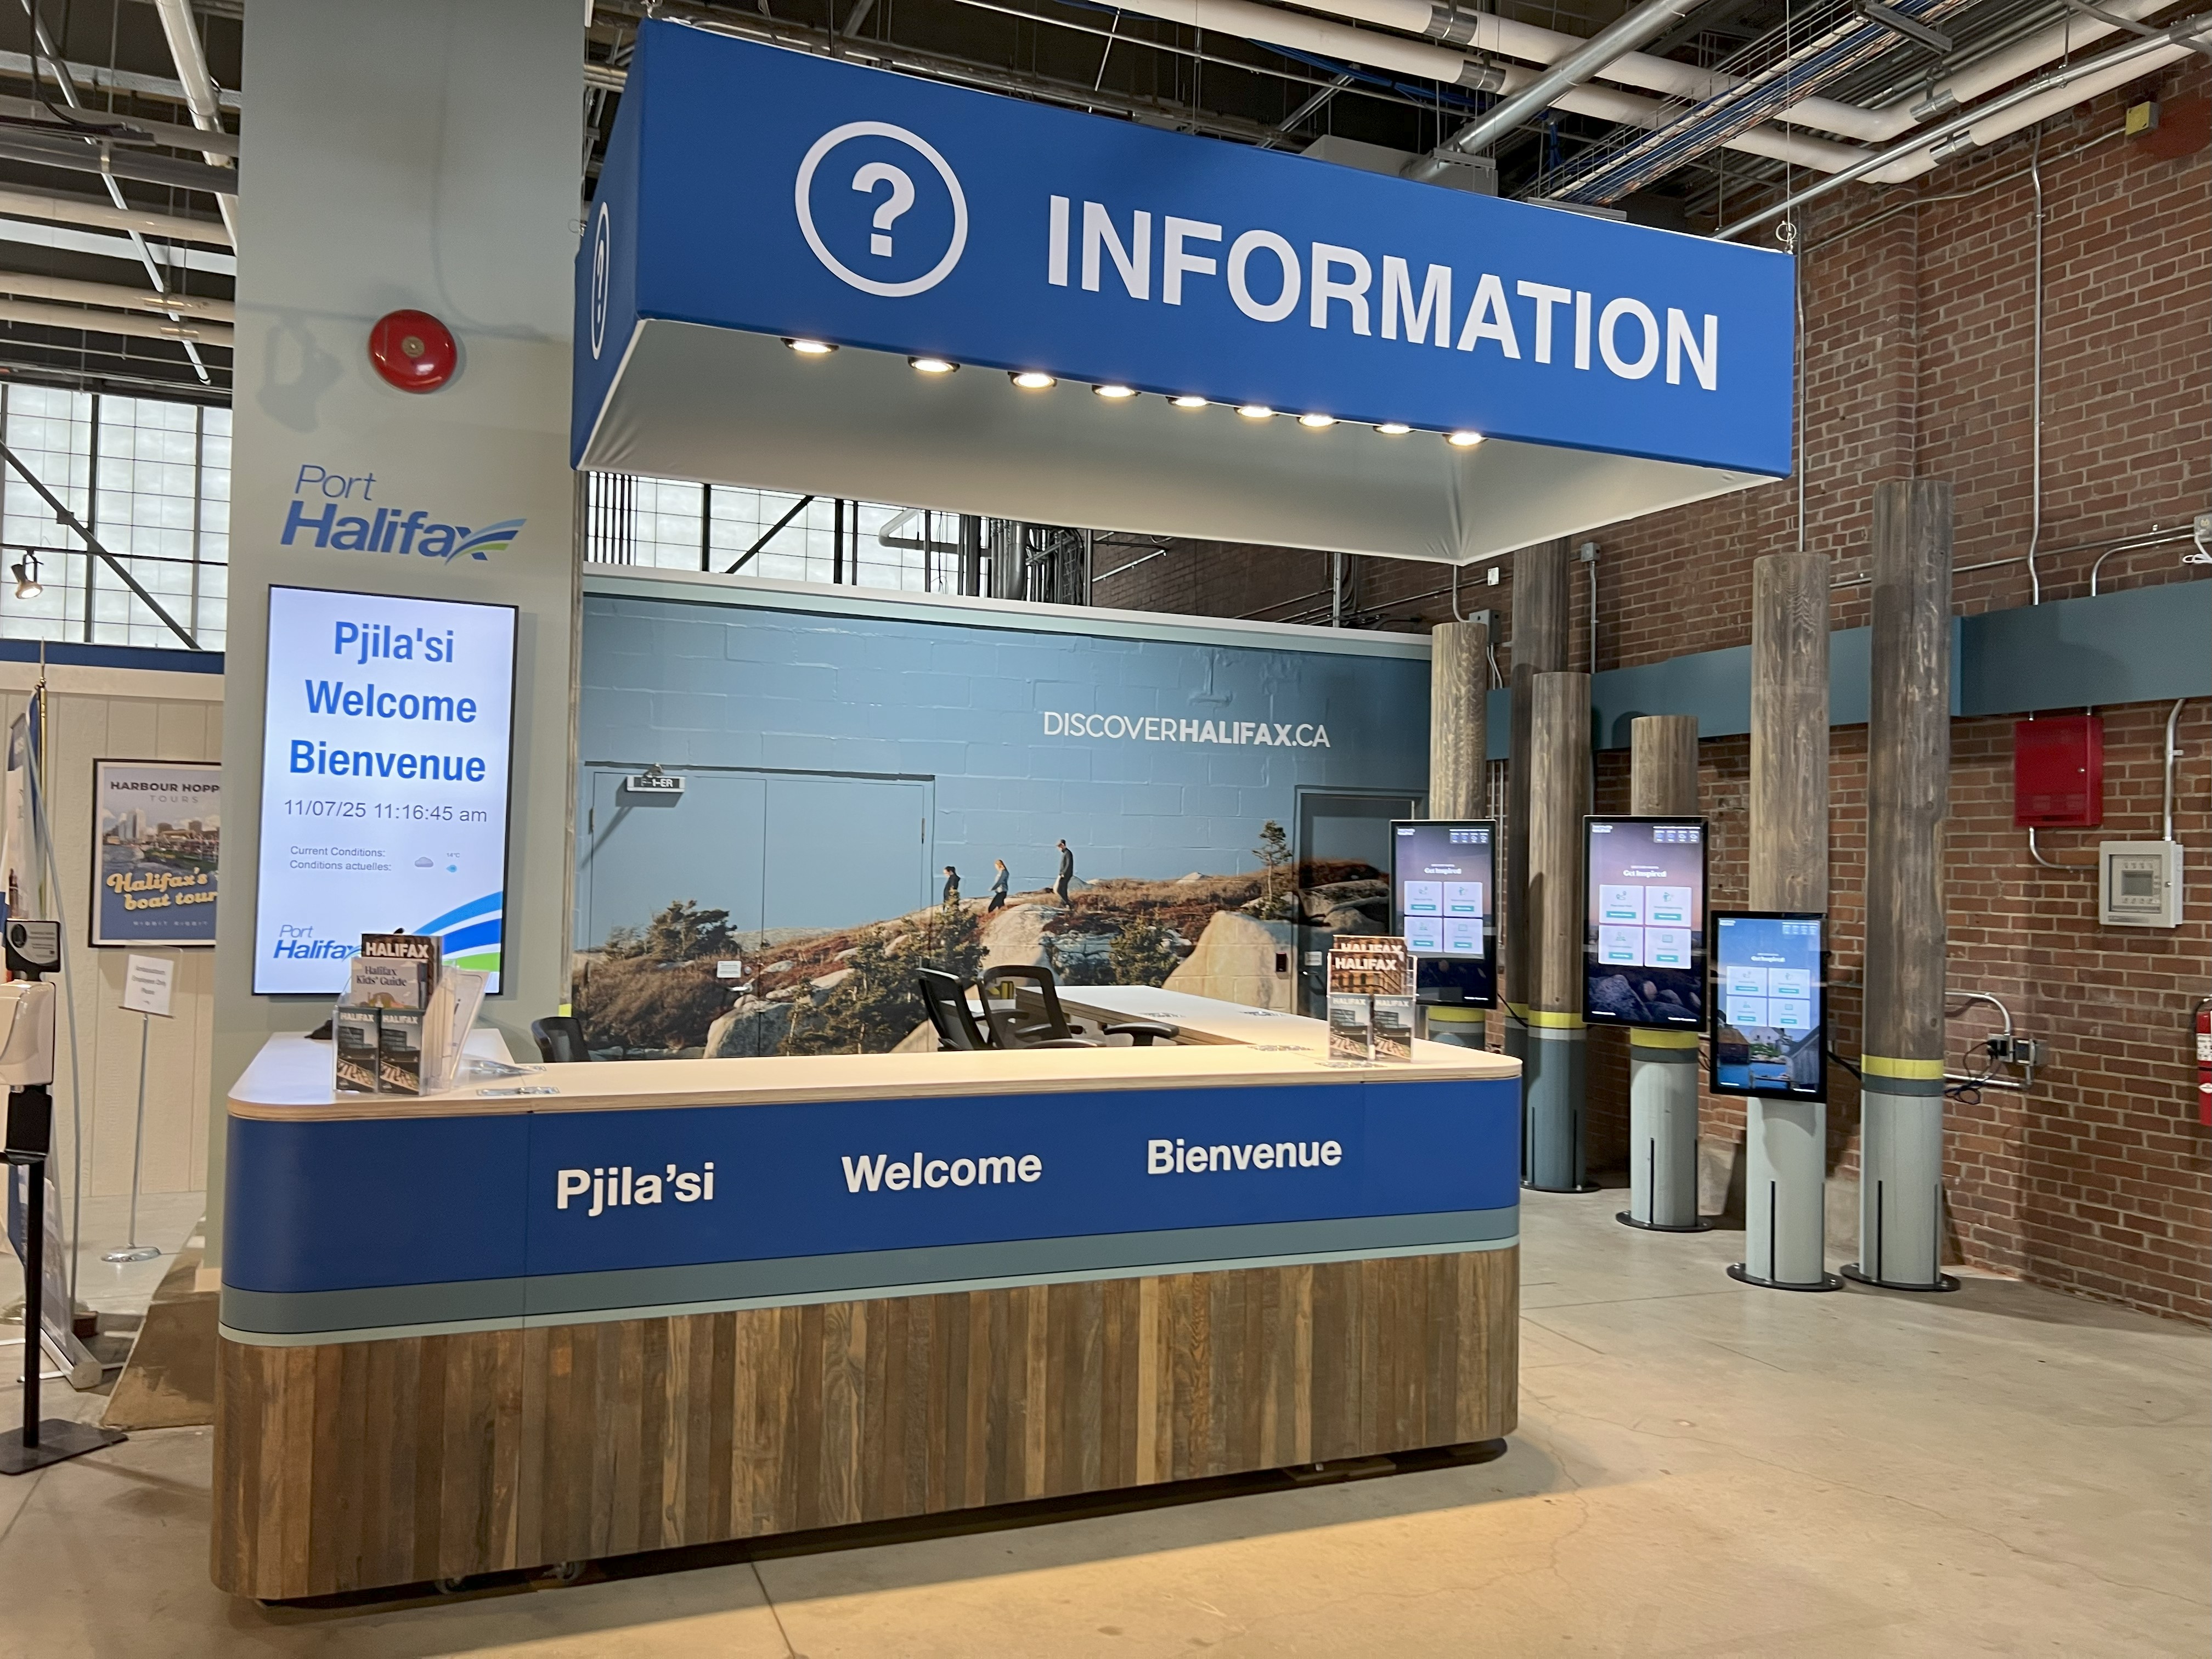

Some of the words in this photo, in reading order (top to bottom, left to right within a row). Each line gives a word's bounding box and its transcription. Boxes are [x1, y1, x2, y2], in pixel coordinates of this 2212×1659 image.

[1048, 194, 1718, 391] INFORMATION
[294, 464, 376, 501] Port
[280, 500, 526, 566] Halifax
[335, 621, 454, 664] Pjila'si
[305, 679, 477, 723] Welcome
[1043, 711, 1331, 748] DISCOVERHALIFAX.CA
[290, 739, 486, 782] Bienvenue
[110, 782, 178, 792] HARBOUR
[284, 799, 366, 817] 11/07/25
[374, 803, 453, 821] 11:16:45
[459, 810, 487, 822] am
[290, 846, 328, 856] Current
[330, 847, 386, 857] Conditions:
[289, 860, 343, 870] Conditions
[345, 862, 392, 871] actuelles:
[106, 867, 208, 893] Halifax's
[124, 894, 171, 910] boat
[279, 924, 314, 938] Port
[365, 942, 430, 958] HALIFAX
[365, 966, 397, 977] Halifax
[1335, 957, 1397, 970] HALIFAX
[380, 977, 408, 987] Guide
[340, 1012, 375, 1023] HALIFAX
[382, 1014, 419, 1025] HALIFAX
[841, 1152, 1043, 1193] Welcome
[1147, 1138, 1343, 1175] Bienvenue
